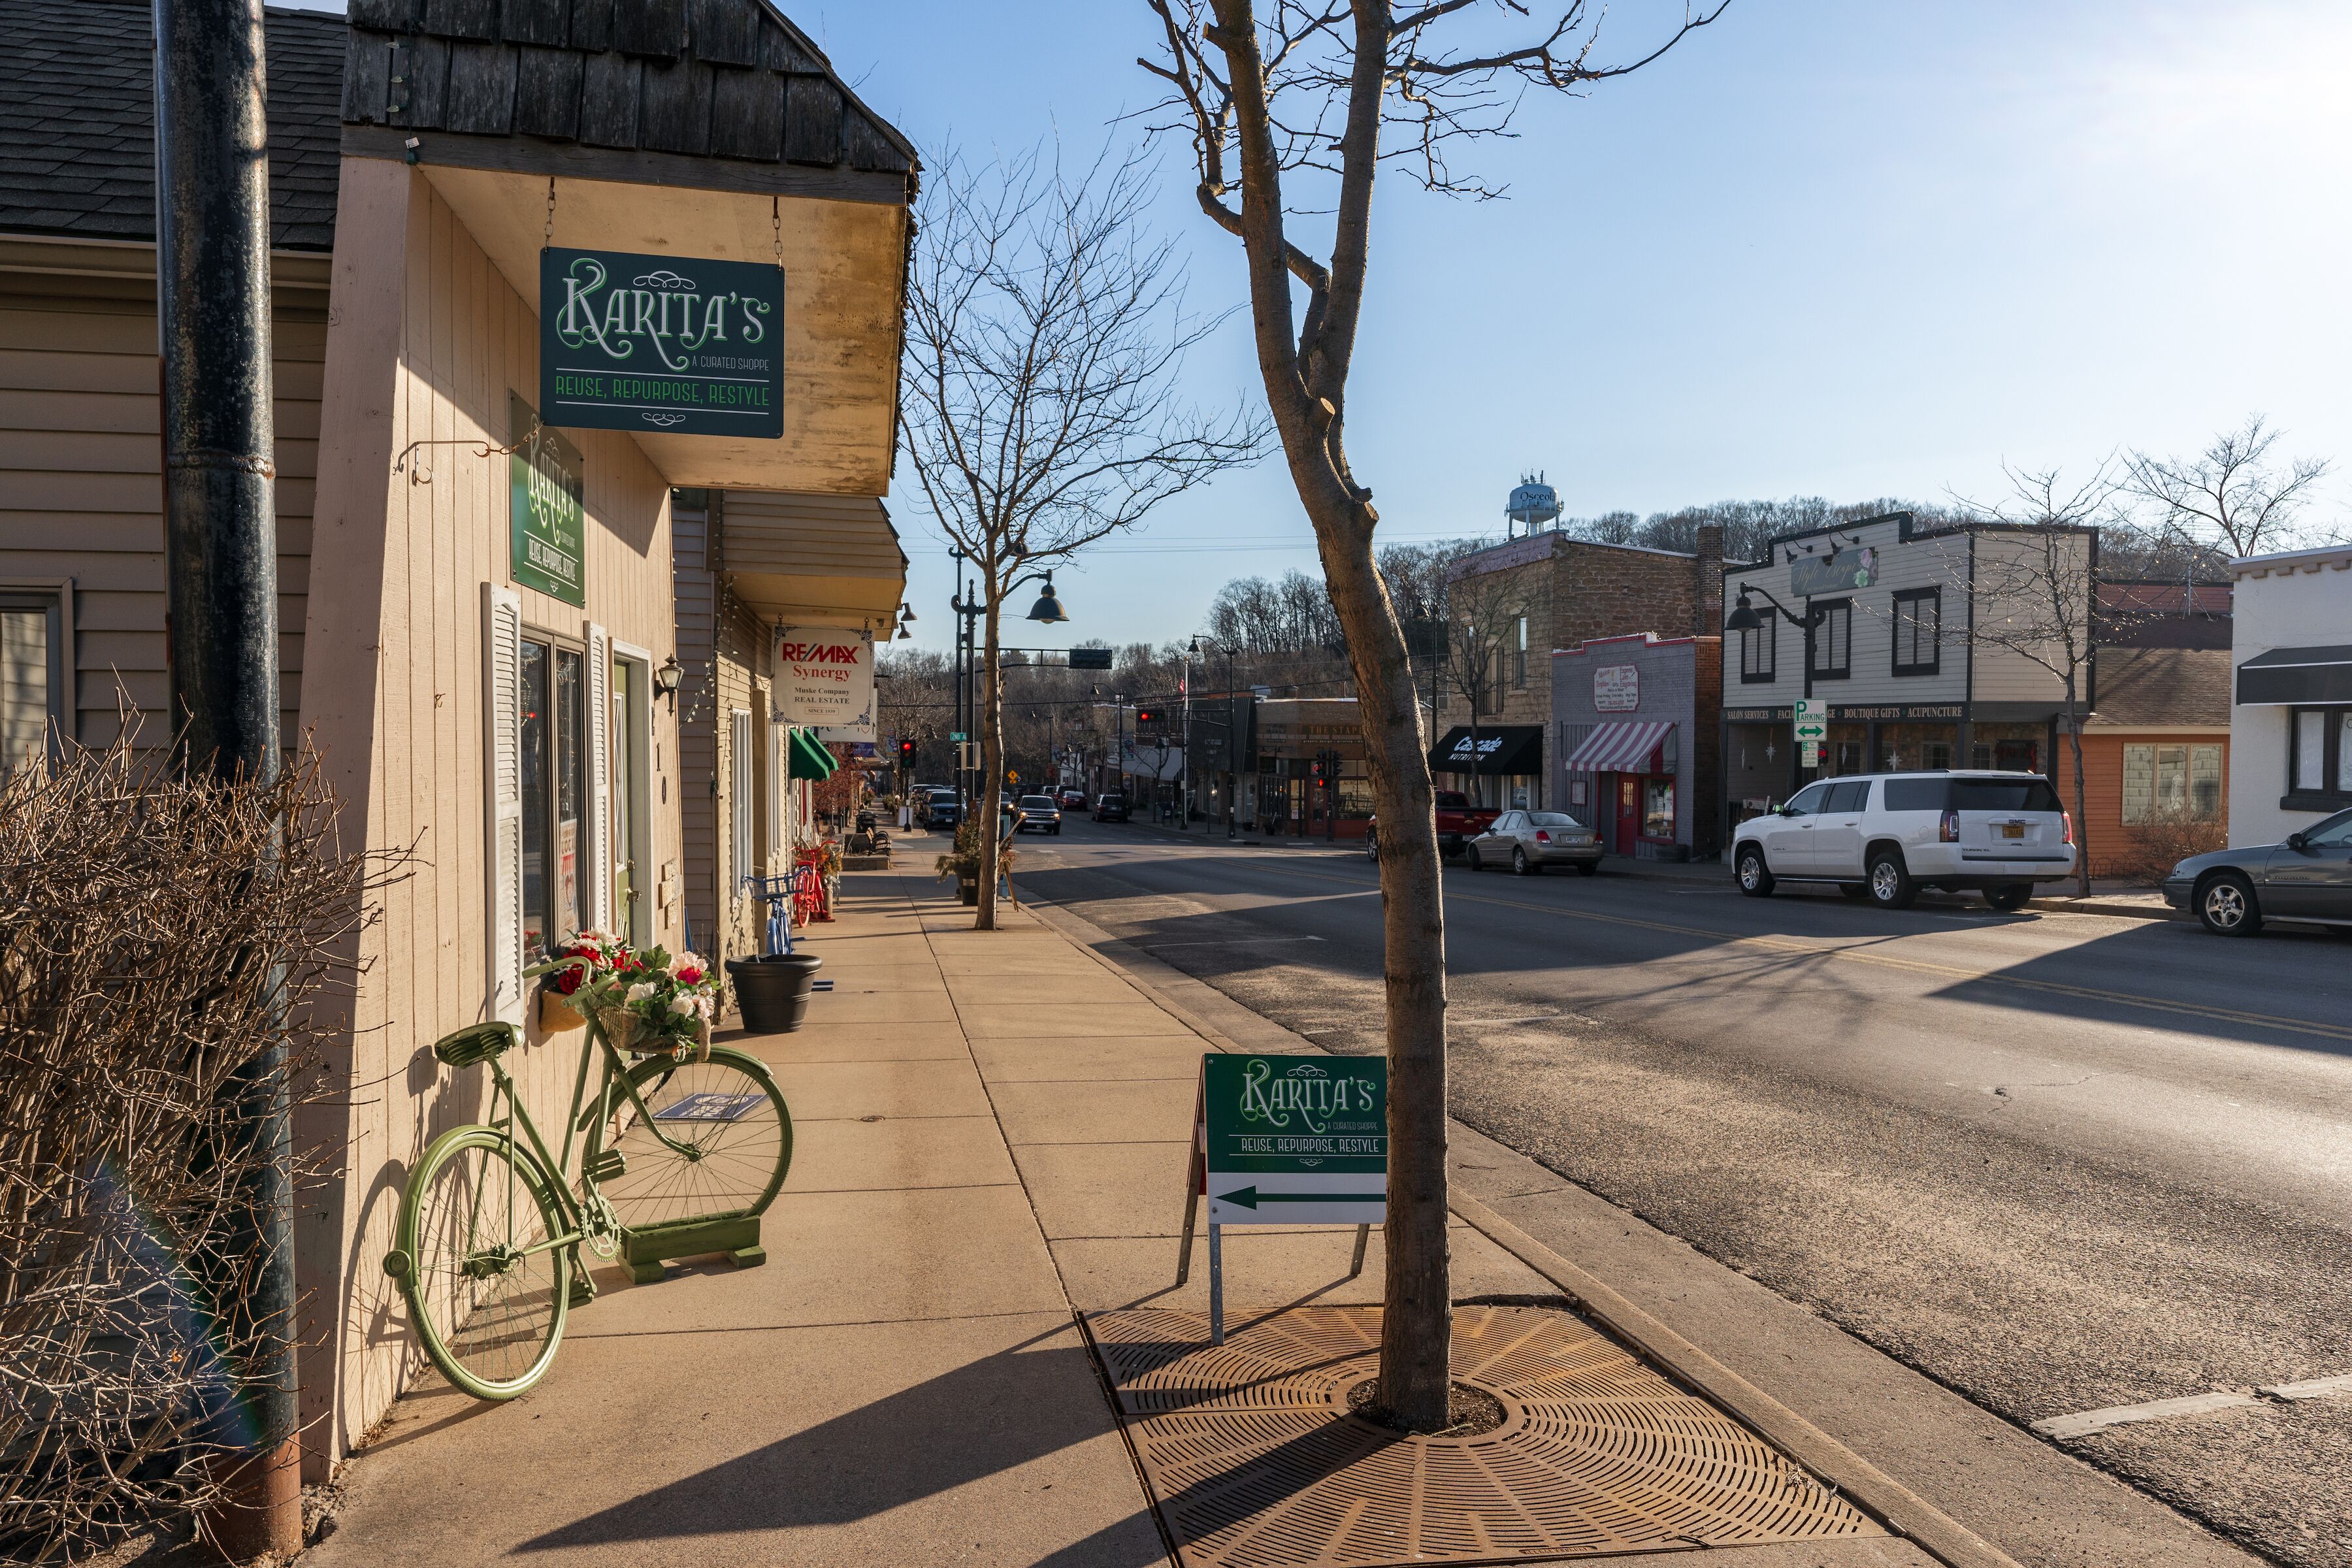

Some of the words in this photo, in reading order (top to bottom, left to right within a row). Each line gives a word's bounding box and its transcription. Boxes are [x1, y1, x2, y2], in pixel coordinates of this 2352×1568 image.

[557, 257, 771, 372] KARITA'S
[692, 355, 697, 367] A
[700, 356, 736, 369] CURATED
[738, 358, 770, 371] SHOPPE
[556, 376, 607, 399] REUSE,
[613, 379, 704, 404] REPURPOSE,
[709, 384, 770, 406] RESTYLE
[1520, 491, 1556, 501] Osceola
[782, 643, 858, 664] RE/MAX
[793, 664, 851, 681] Synergy
[1727, 710, 1743, 719] SALON
[1744, 710, 1769, 719] SERVICES
[1777, 710, 1794, 719] FACIA
[1796, 701, 1825, 721] PARKING
[1844, 708, 1879, 719] BOUTIQUE
[1880, 708, 1900, 718] GIFTS
[1907, 706, 1962, 717] ACUPUNCTURE
[1309, 726, 1328, 734] THE
[1333, 726, 1363, 734] STAPL
[1240, 1059, 1376, 1134] KARITA'S
[1327, 1122, 1332, 1130] A
[1333, 1122, 1356, 1130] CURATED
[1357, 1122, 1378, 1131] SHOPPE
[1241, 1138, 1275, 1153] REUSE,
[1278, 1138, 1336, 1153] REPURPOSE,
[1339, 1139, 1379, 1152] RESTYLE
